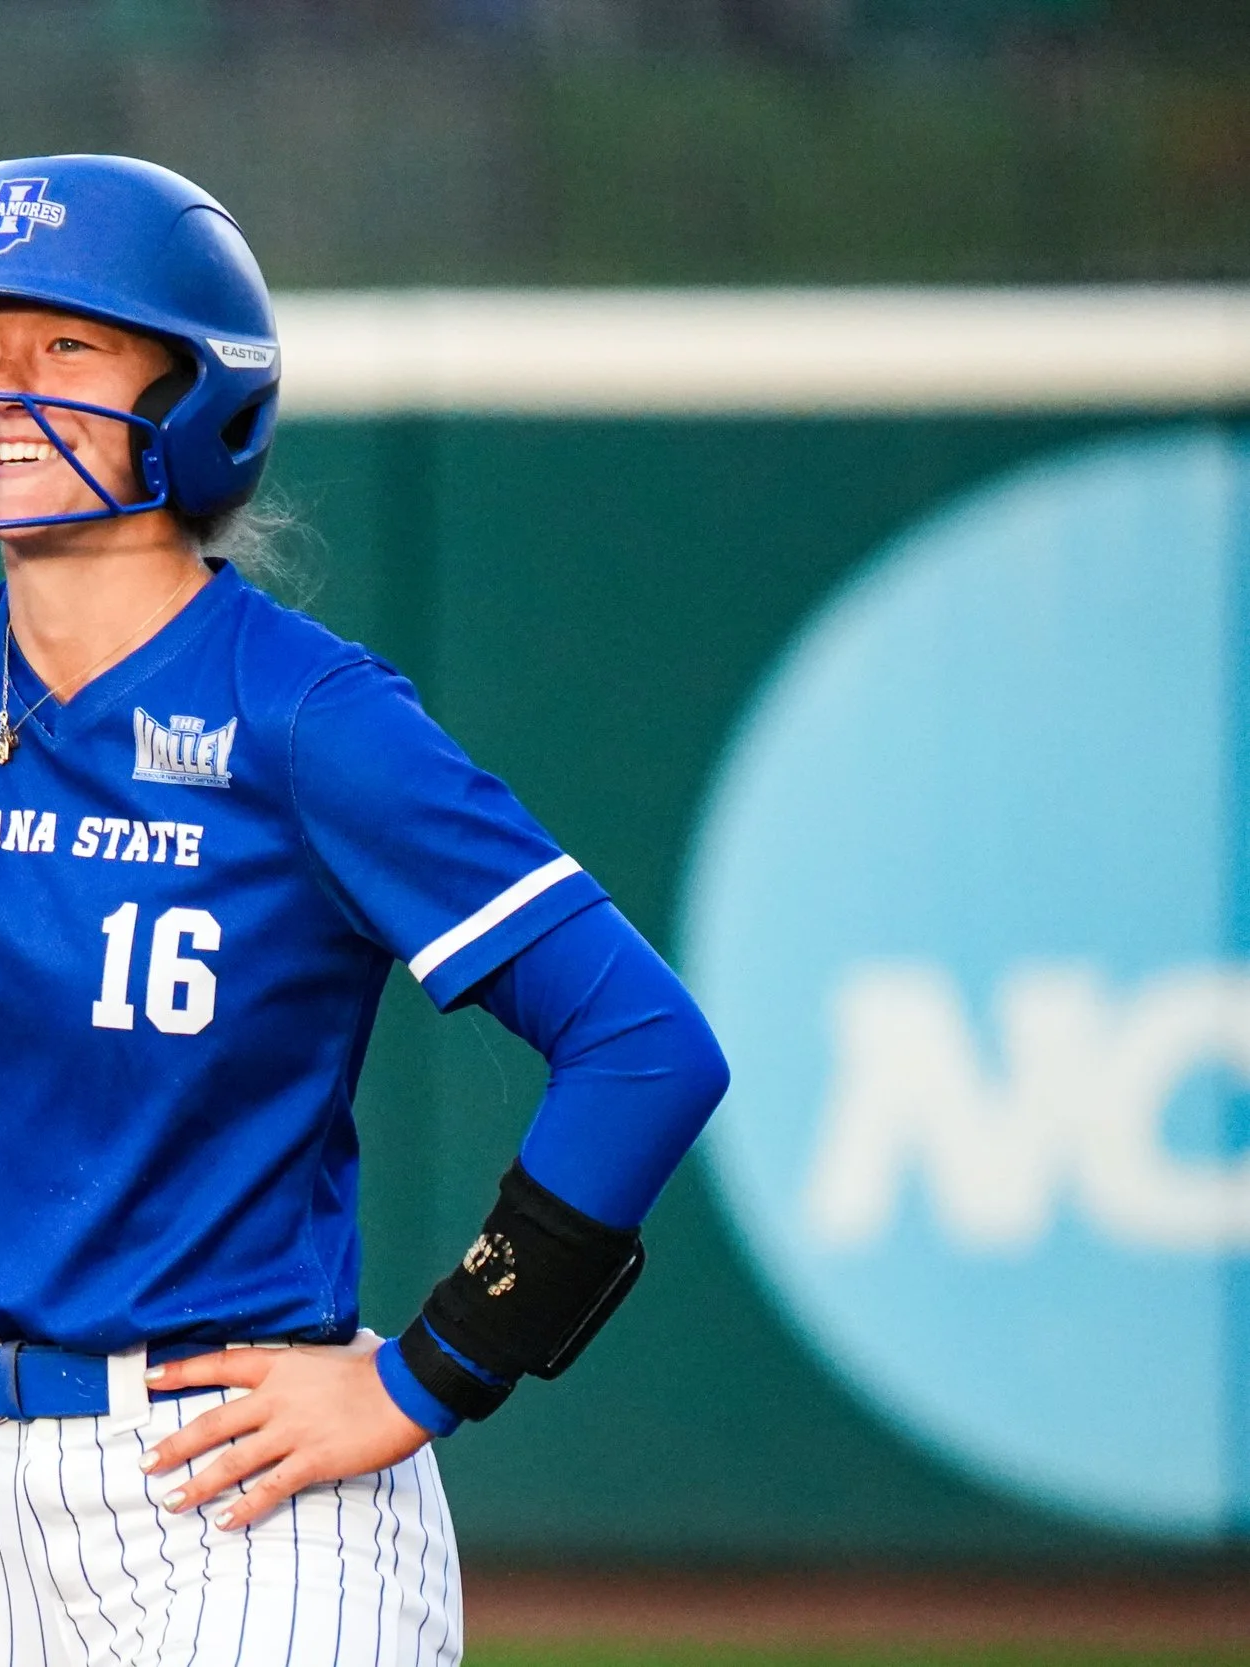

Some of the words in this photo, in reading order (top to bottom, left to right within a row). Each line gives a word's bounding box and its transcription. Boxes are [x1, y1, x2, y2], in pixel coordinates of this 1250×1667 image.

[221, 345, 267, 362] EASTON
[134, 708, 236, 777] VALLEY
[171, 718, 203, 731] THE
[72, 816, 203, 867] STATE
[92, 901, 222, 1035] 16
